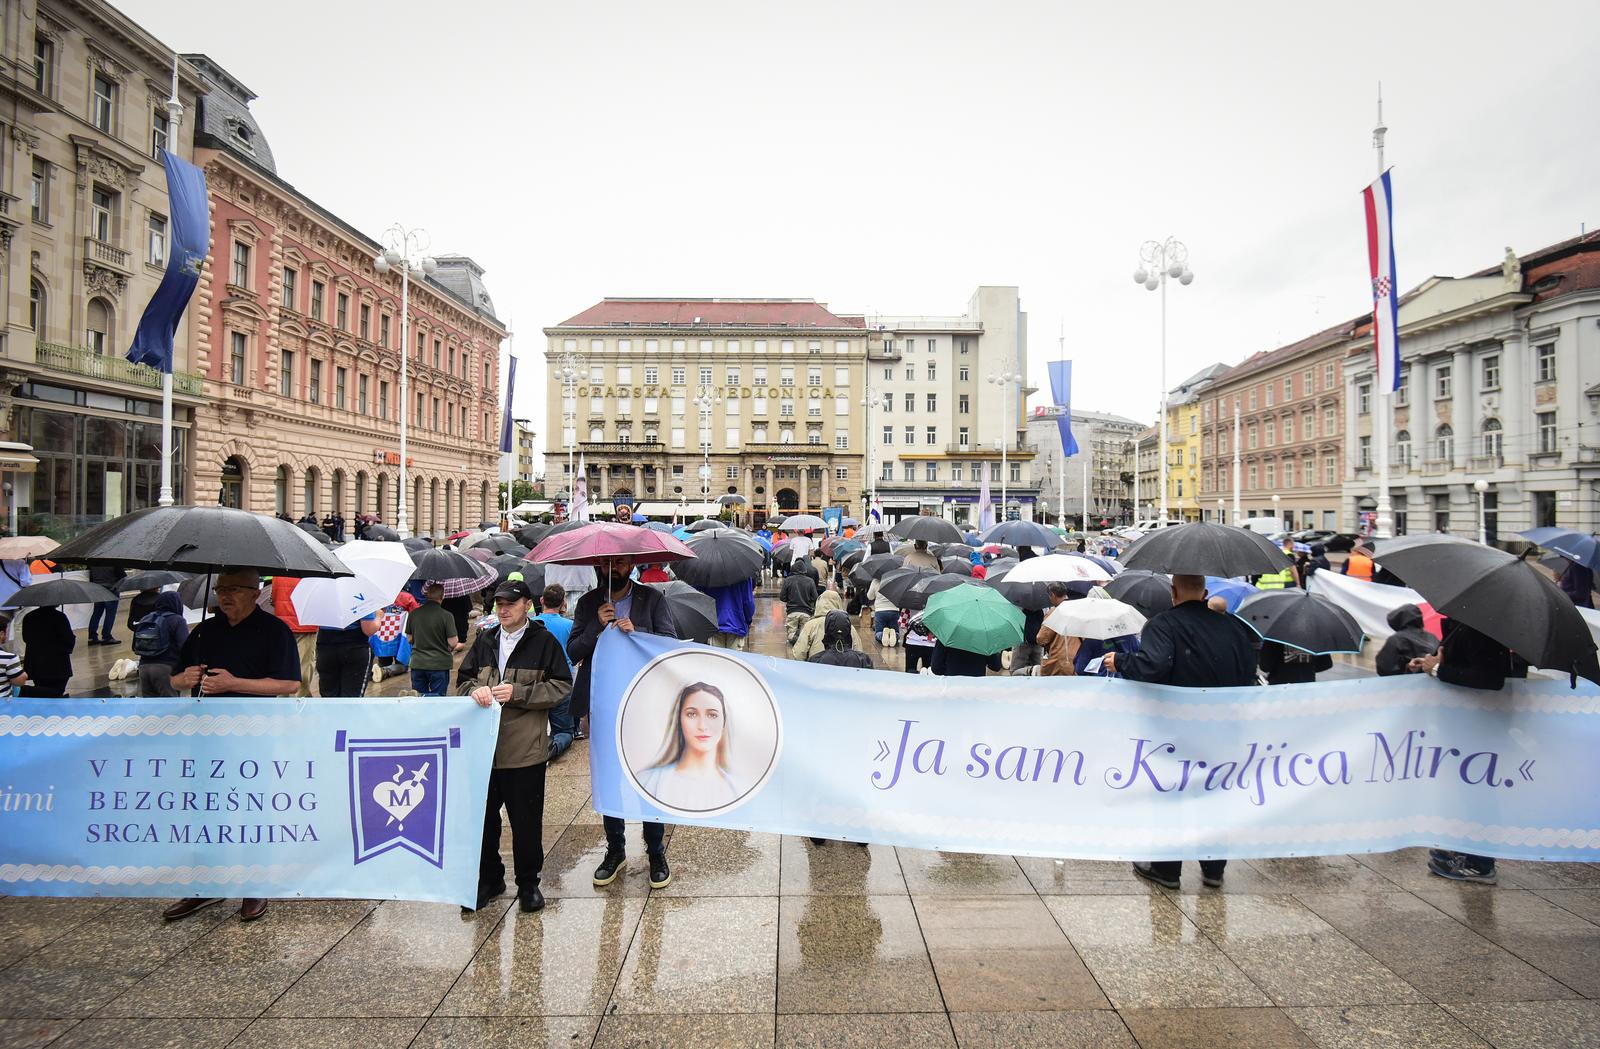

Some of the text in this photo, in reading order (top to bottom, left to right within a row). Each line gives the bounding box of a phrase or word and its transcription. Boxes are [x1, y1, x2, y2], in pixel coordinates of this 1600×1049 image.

[577, 386, 834, 399] GRADSKA TEDIONICA
[386, 451, 414, 467] Müer
[88, 758, 315, 779] VITEZOVI
[870, 719, 1536, 806] »Ja sam Kraljica Mira.«
[0, 784, 54, 811] imi
[88, 786, 318, 812] BEZGREŠNOG
[86, 823, 321, 844] SRCA MARIJINA
